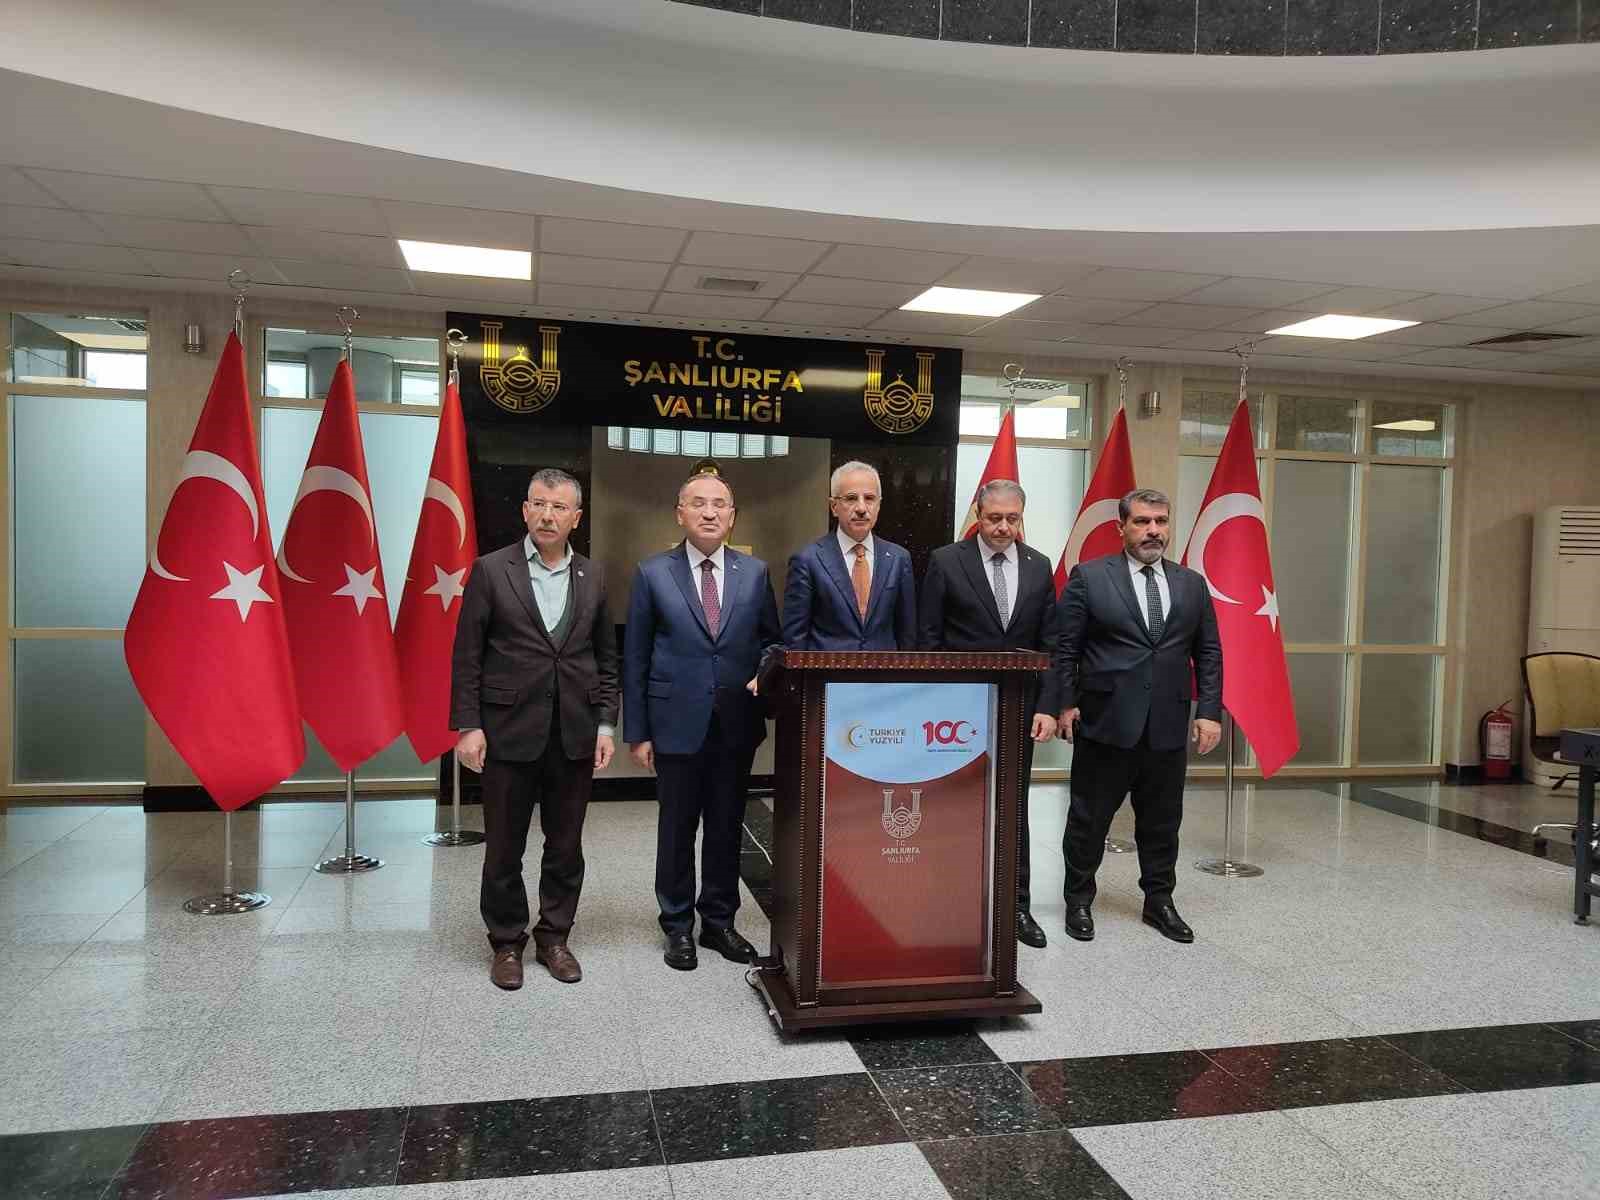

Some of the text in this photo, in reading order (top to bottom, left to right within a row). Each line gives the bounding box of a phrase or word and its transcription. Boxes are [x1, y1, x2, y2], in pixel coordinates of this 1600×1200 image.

[692, 336, 744, 361] T.C.
[624, 360, 804, 392] ŞANLIURFA
[653, 393, 782, 423] VALİLİĞİ
